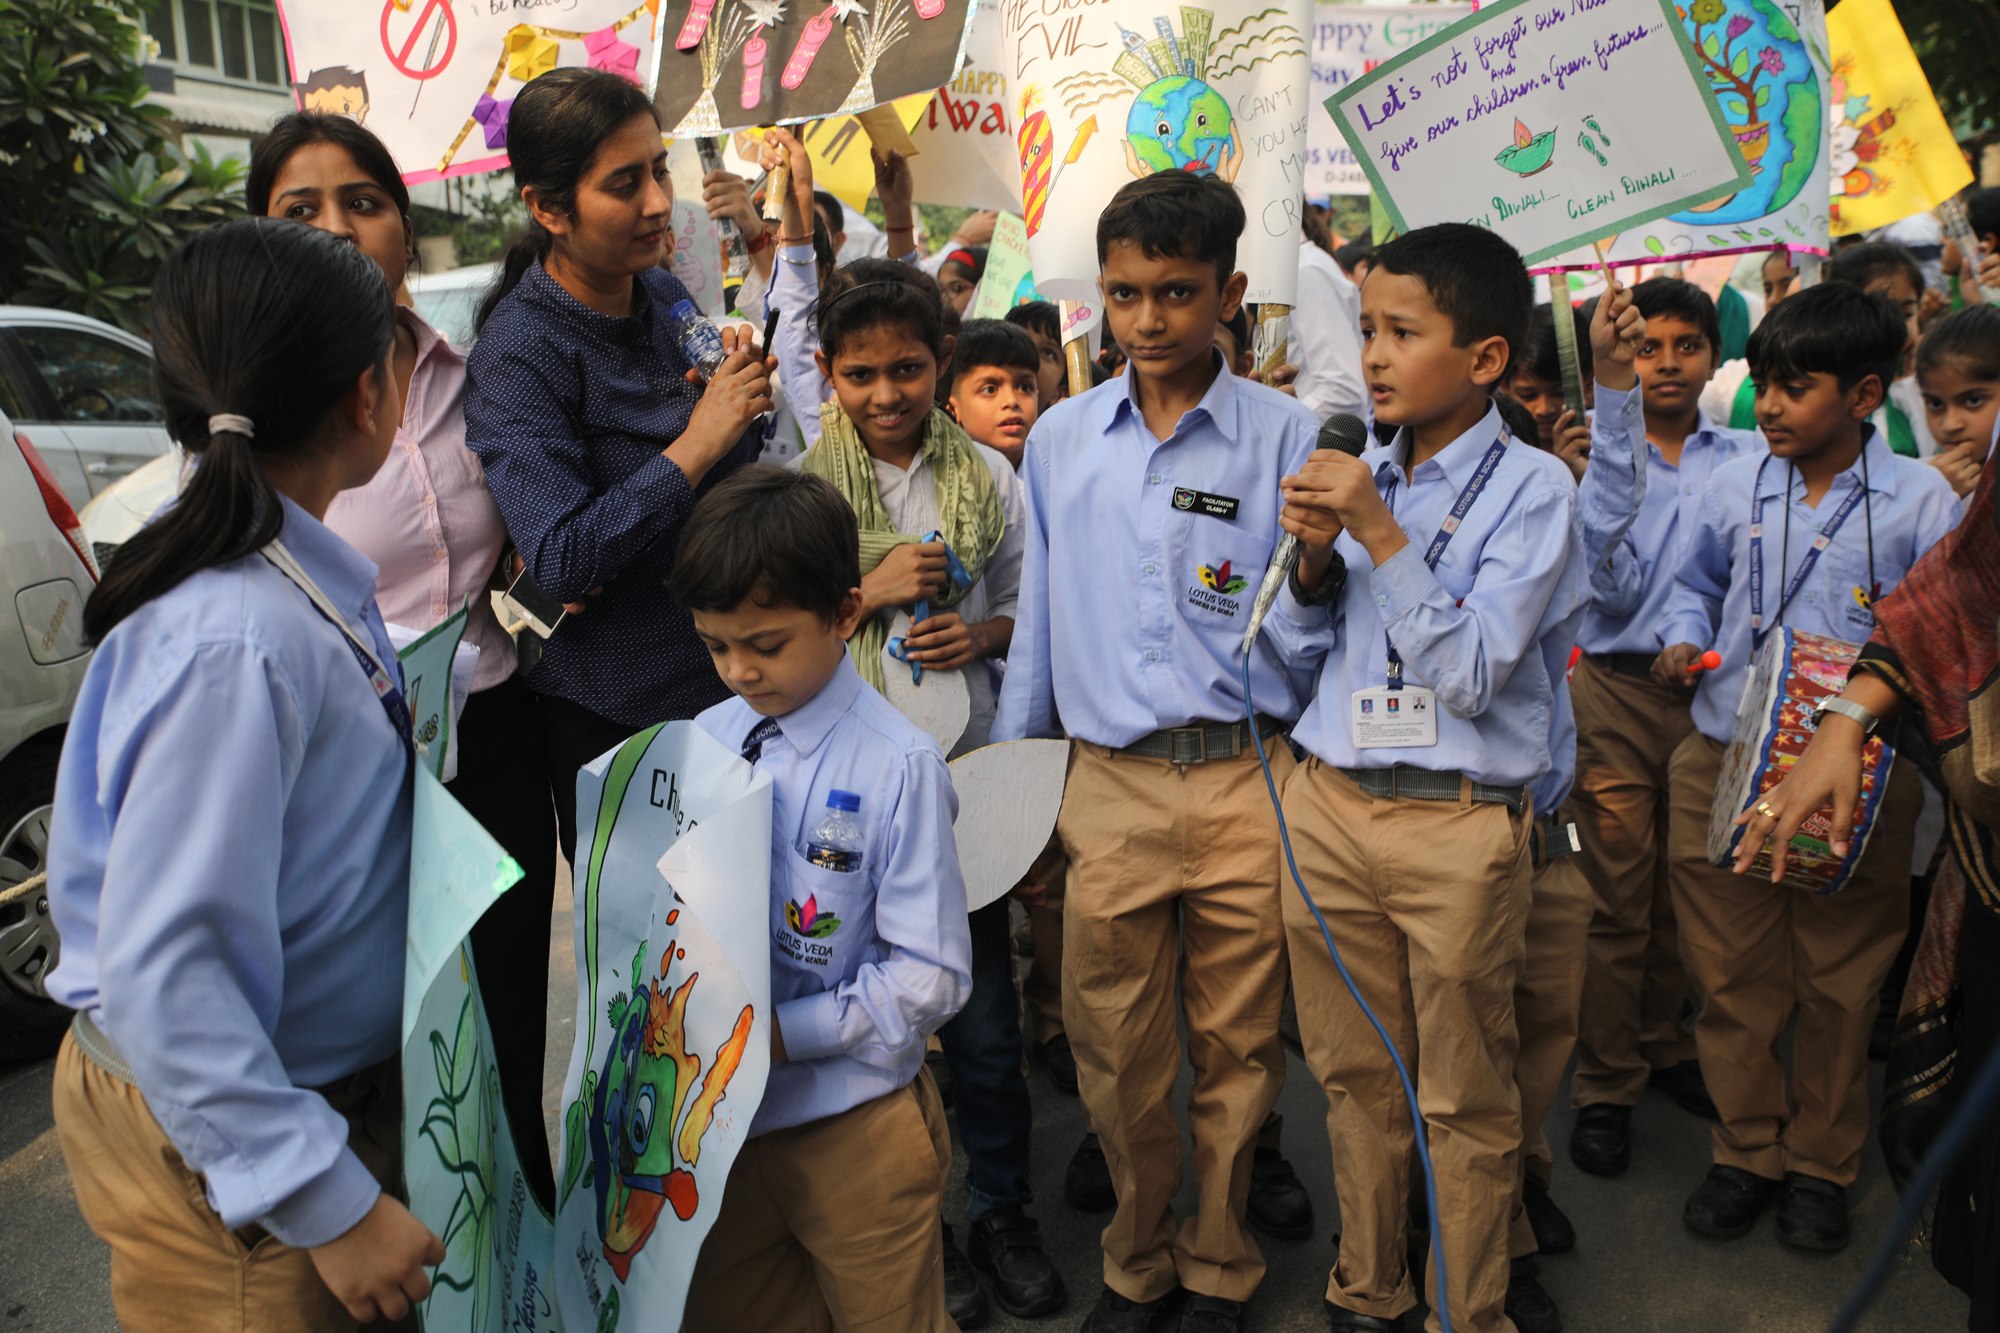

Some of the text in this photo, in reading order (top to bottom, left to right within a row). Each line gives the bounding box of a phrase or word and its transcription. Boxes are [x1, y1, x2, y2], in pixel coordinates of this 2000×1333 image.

[1016, 13, 1108, 80] EVIL
[1312, 22, 1373, 53] ppy
[1357, 7, 1565, 131] Let's not forget our
[928, 86, 1013, 137] iwa
[1237, 85, 1292, 122] CAN'T
[1427, 116, 1459, 142] our
[1466, 76, 1539, 122] children
[1541, 73, 1551, 84] a
[1250, 129, 1285, 158] YOU
[1567, 190, 1616, 220] CLEAN
[1620, 167, 1676, 195] DIWALI
[1455, 491, 1474, 516] LOTUS
[1480, 448, 1501, 475] SCHOOL
[1188, 586, 1240, 611] LOTUS VEDA
[776, 928, 833, 958] LOTUS VEDA
